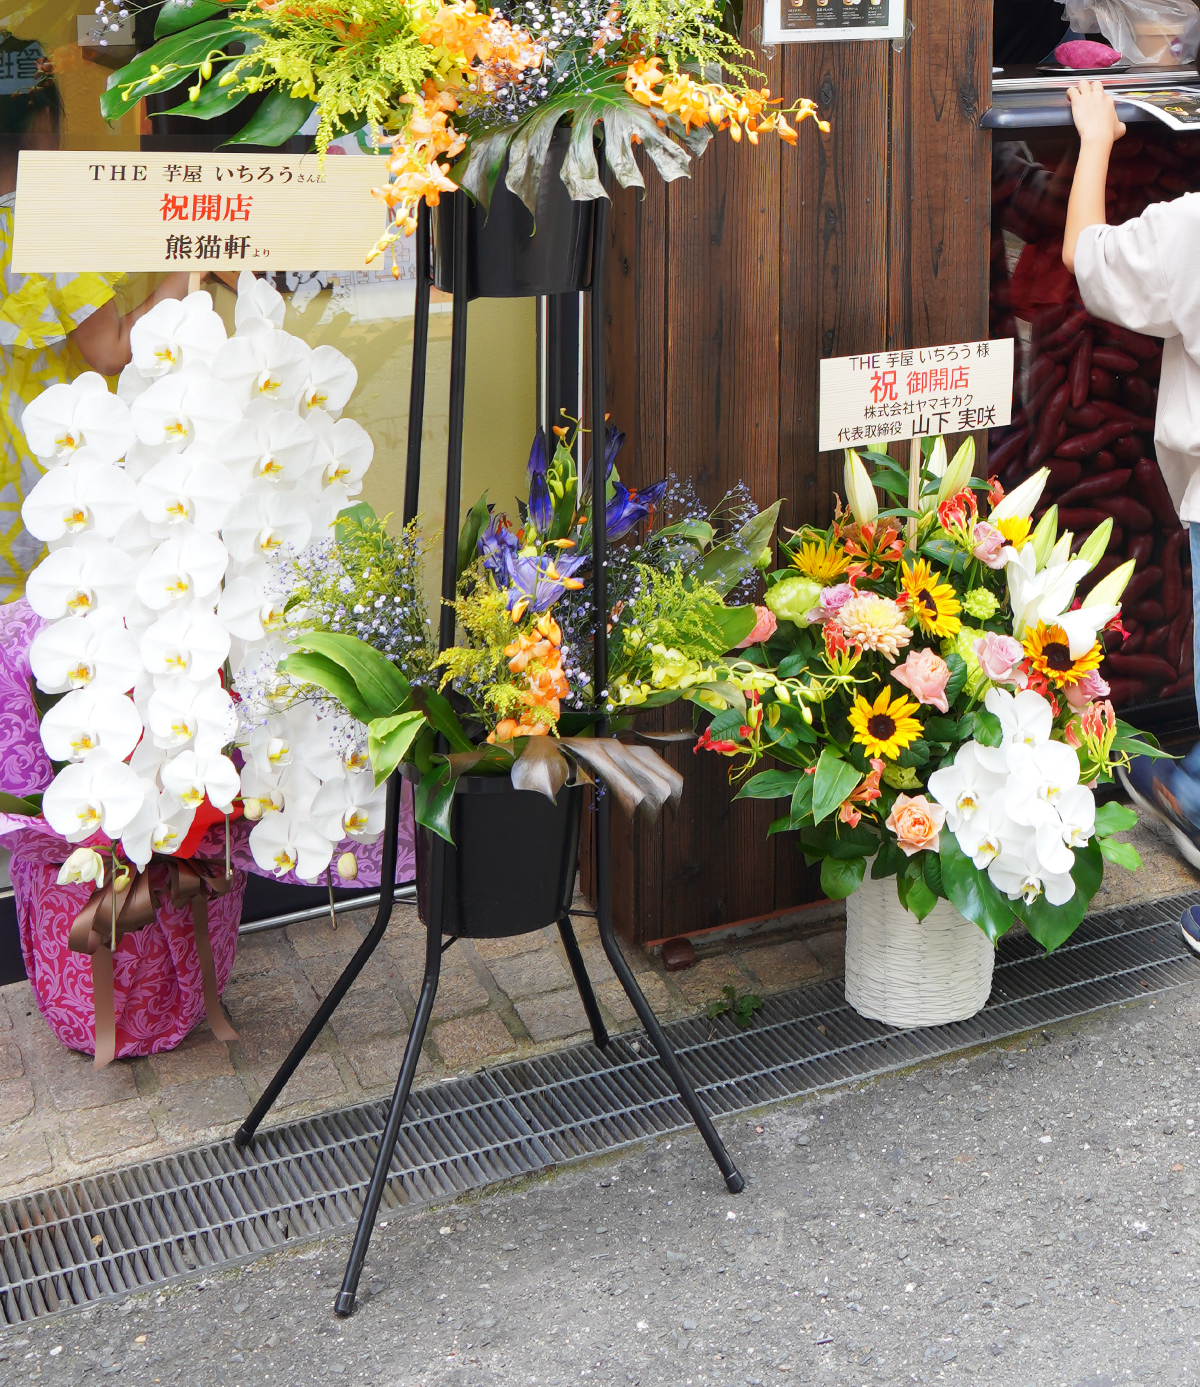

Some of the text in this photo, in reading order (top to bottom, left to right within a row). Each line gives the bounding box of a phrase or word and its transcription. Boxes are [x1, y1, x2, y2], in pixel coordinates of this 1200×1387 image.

[89, 164, 148, 182] THE
[163, 164, 203, 184] 芋屋
[159, 193, 253, 222] 祝開店
[849, 343, 990, 371] THE 芋屋 いちろう 様
[870, 365, 971, 404] 祝 御開店
[864, 393, 974, 420] 株式会社ヤマキカク
[838, 422, 903, 443] 代表取締役
